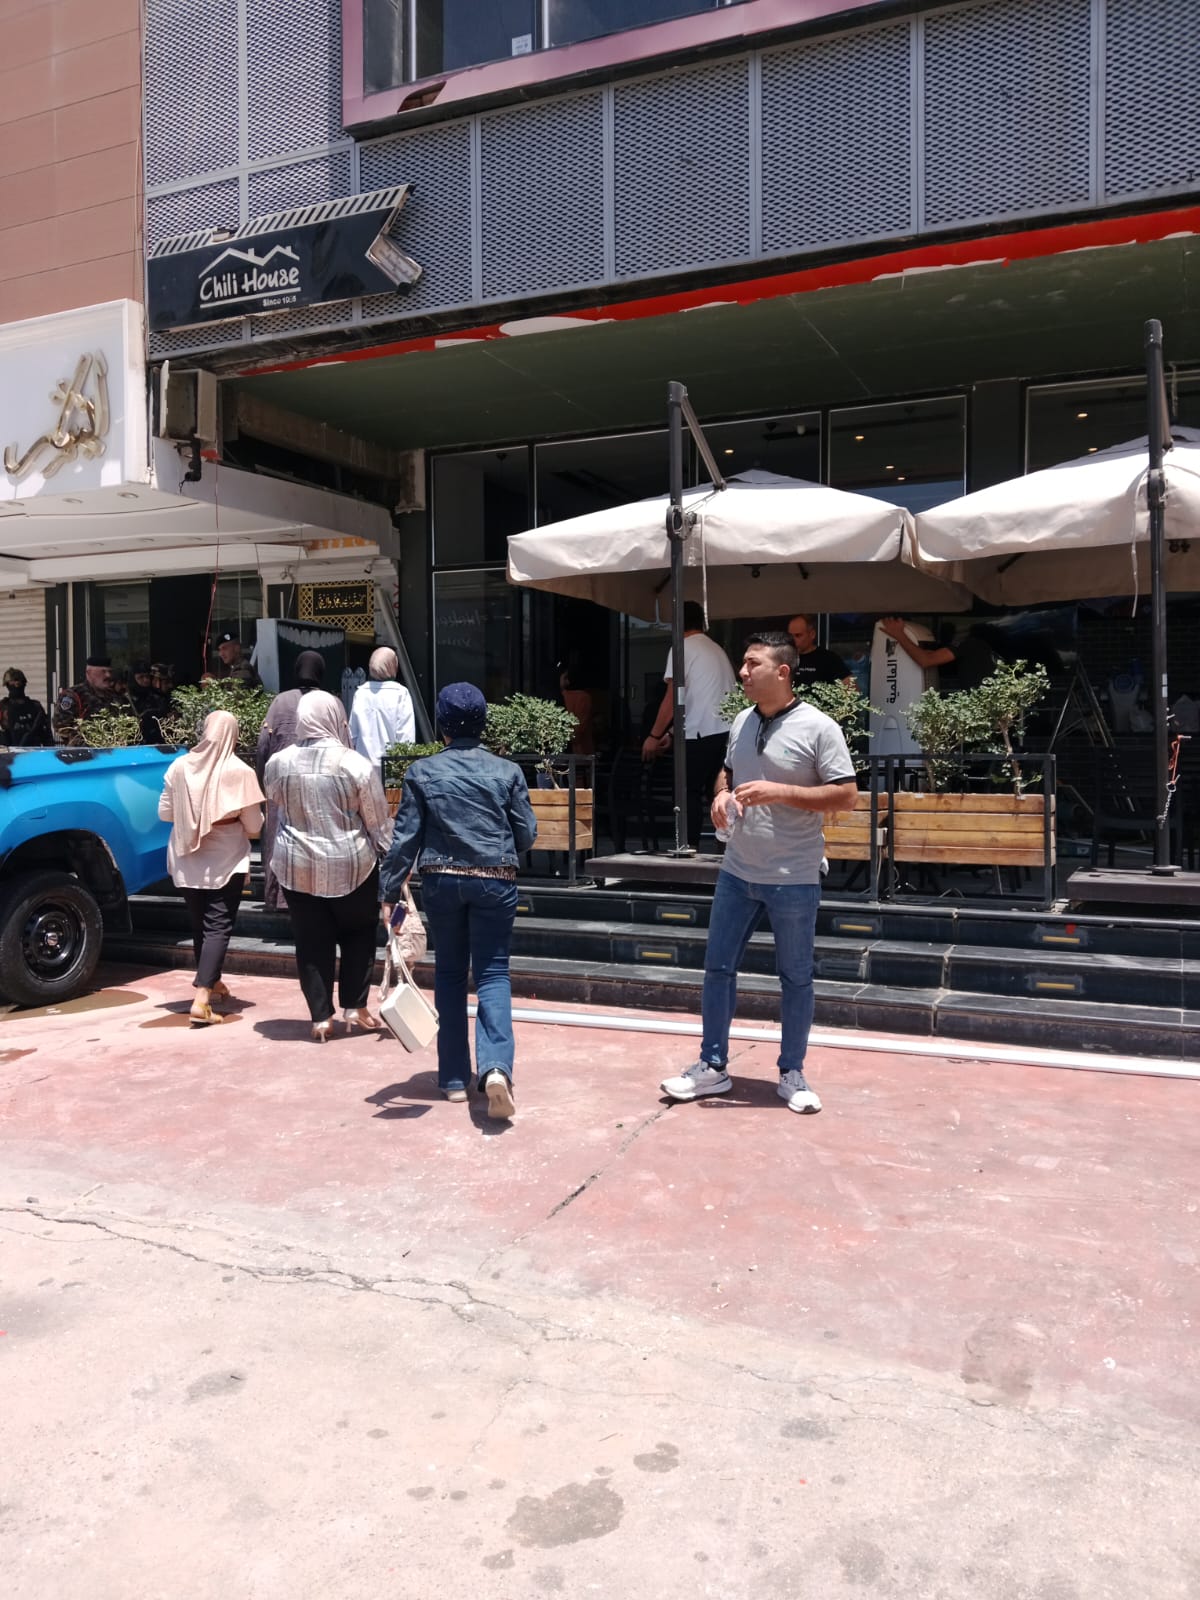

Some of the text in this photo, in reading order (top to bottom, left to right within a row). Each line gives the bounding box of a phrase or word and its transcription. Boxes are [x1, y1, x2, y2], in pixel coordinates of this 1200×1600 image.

[200, 267, 300, 301] Chili House
[262, 298, 281, 307] Since
[886, 659, 900, 704] العالمية
